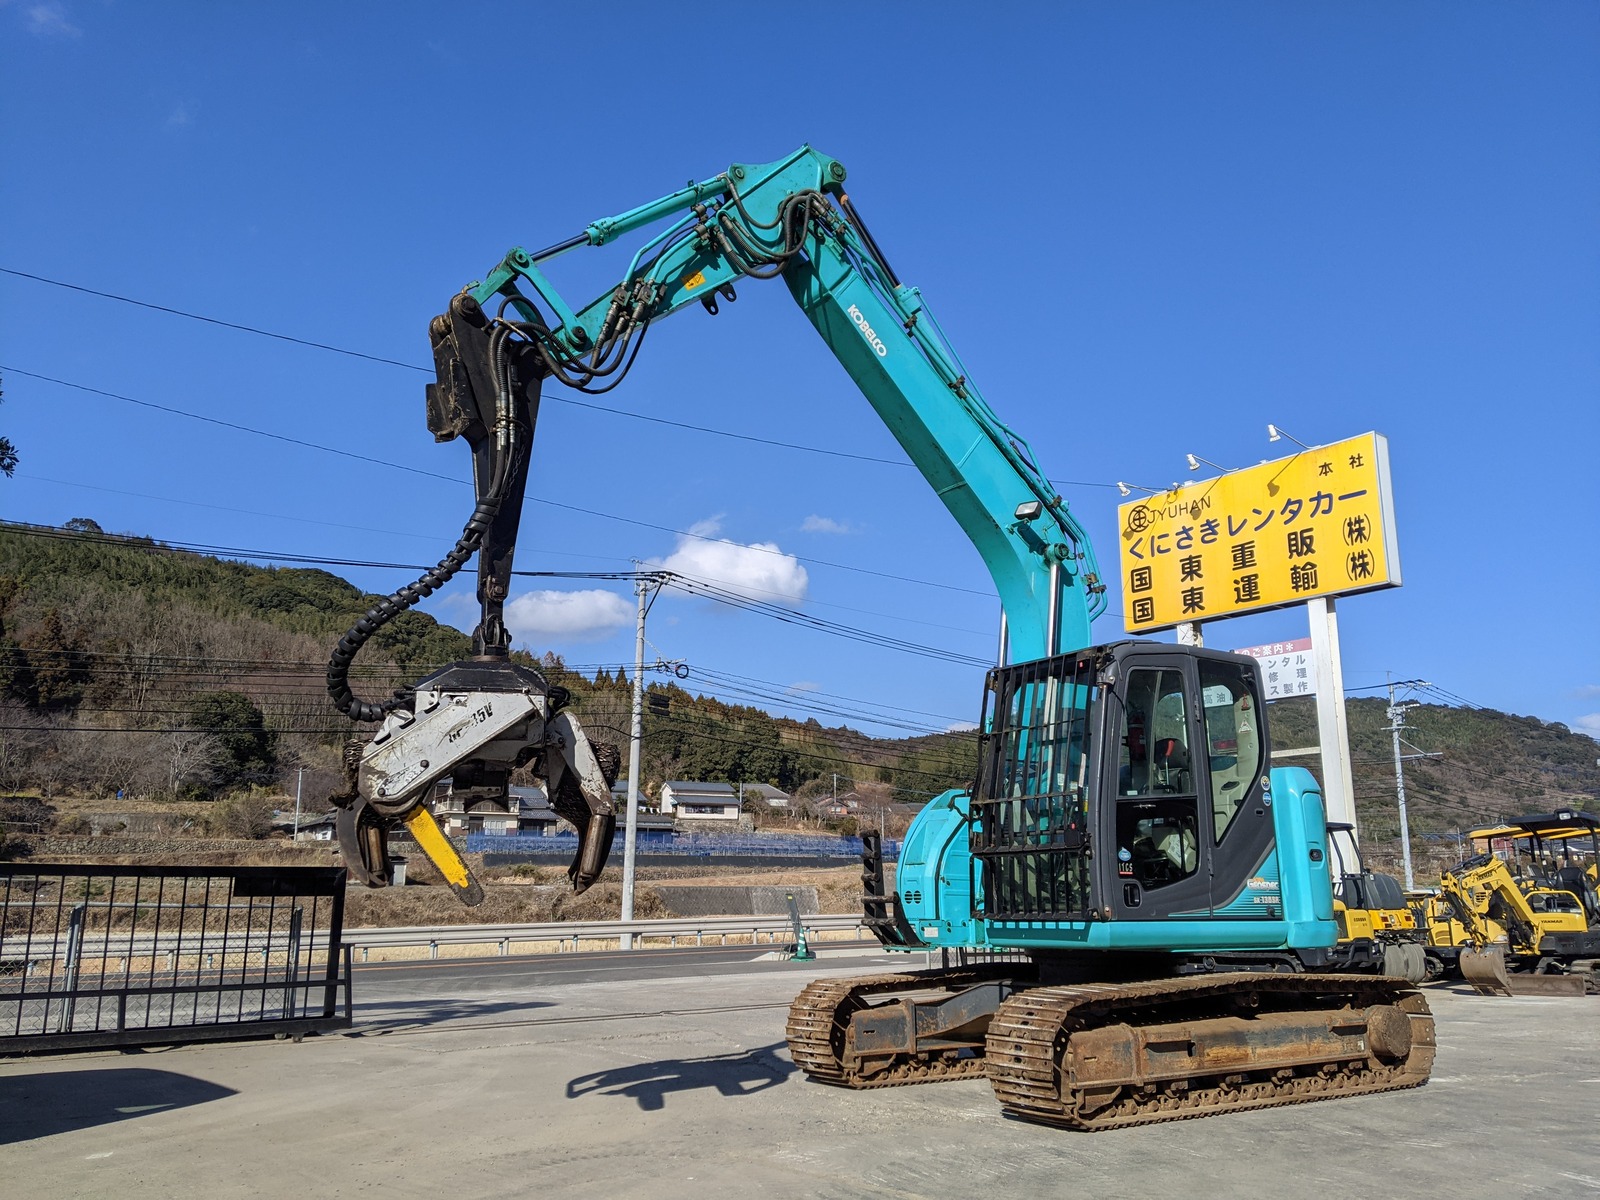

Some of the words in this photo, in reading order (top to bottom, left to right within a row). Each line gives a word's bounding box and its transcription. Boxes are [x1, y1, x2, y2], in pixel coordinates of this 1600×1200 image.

[847, 304, 887, 357] KOBELCO
[1318, 453, 1365, 476] 本社
[1147, 495, 1211, 524] JYUHAN
[1129, 489, 1367, 560] くにさきレンタカー
[1261, 654, 1306, 669] ンタル
[1268, 667, 1308, 683] 修理
